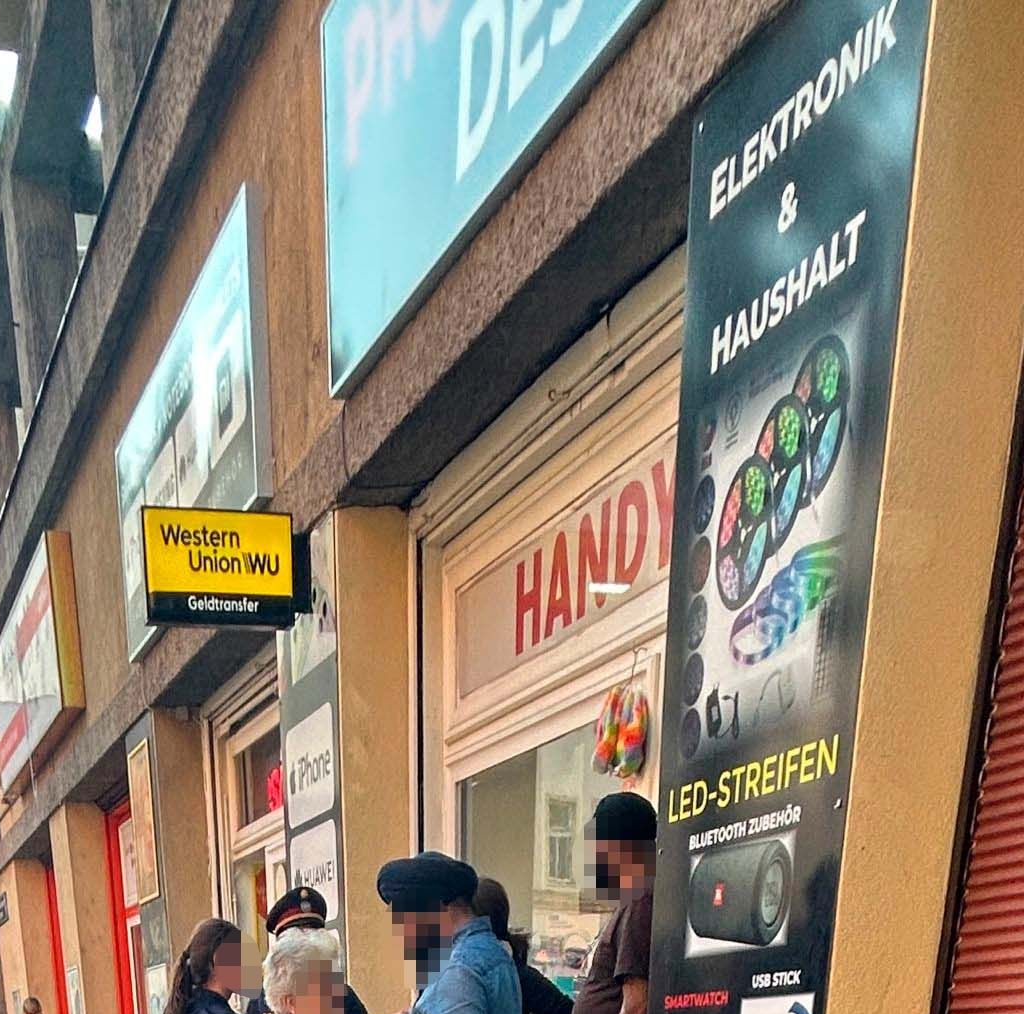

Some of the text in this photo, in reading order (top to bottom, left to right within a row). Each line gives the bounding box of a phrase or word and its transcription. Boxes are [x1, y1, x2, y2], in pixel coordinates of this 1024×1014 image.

[709, 0, 899, 221] ELEKTRONIK
[777, 181, 799, 234] &
[710, 208, 868, 376] HAUSHALT
[160, 523, 240, 549] Western
[188, 549, 280, 576] Union WU
[187, 595, 260, 613] Geldtransfer
[298, 749, 331, 790] iPhone
[668, 733, 840, 824] LED-STREIFEN
[688, 804, 803, 851] BLUETOOTH ZUBEHÖR
[303, 860, 336, 887] HUAWEI
[752, 969, 802, 989] USB STICK
[664, 990, 729, 1010] SMARTWATCH
